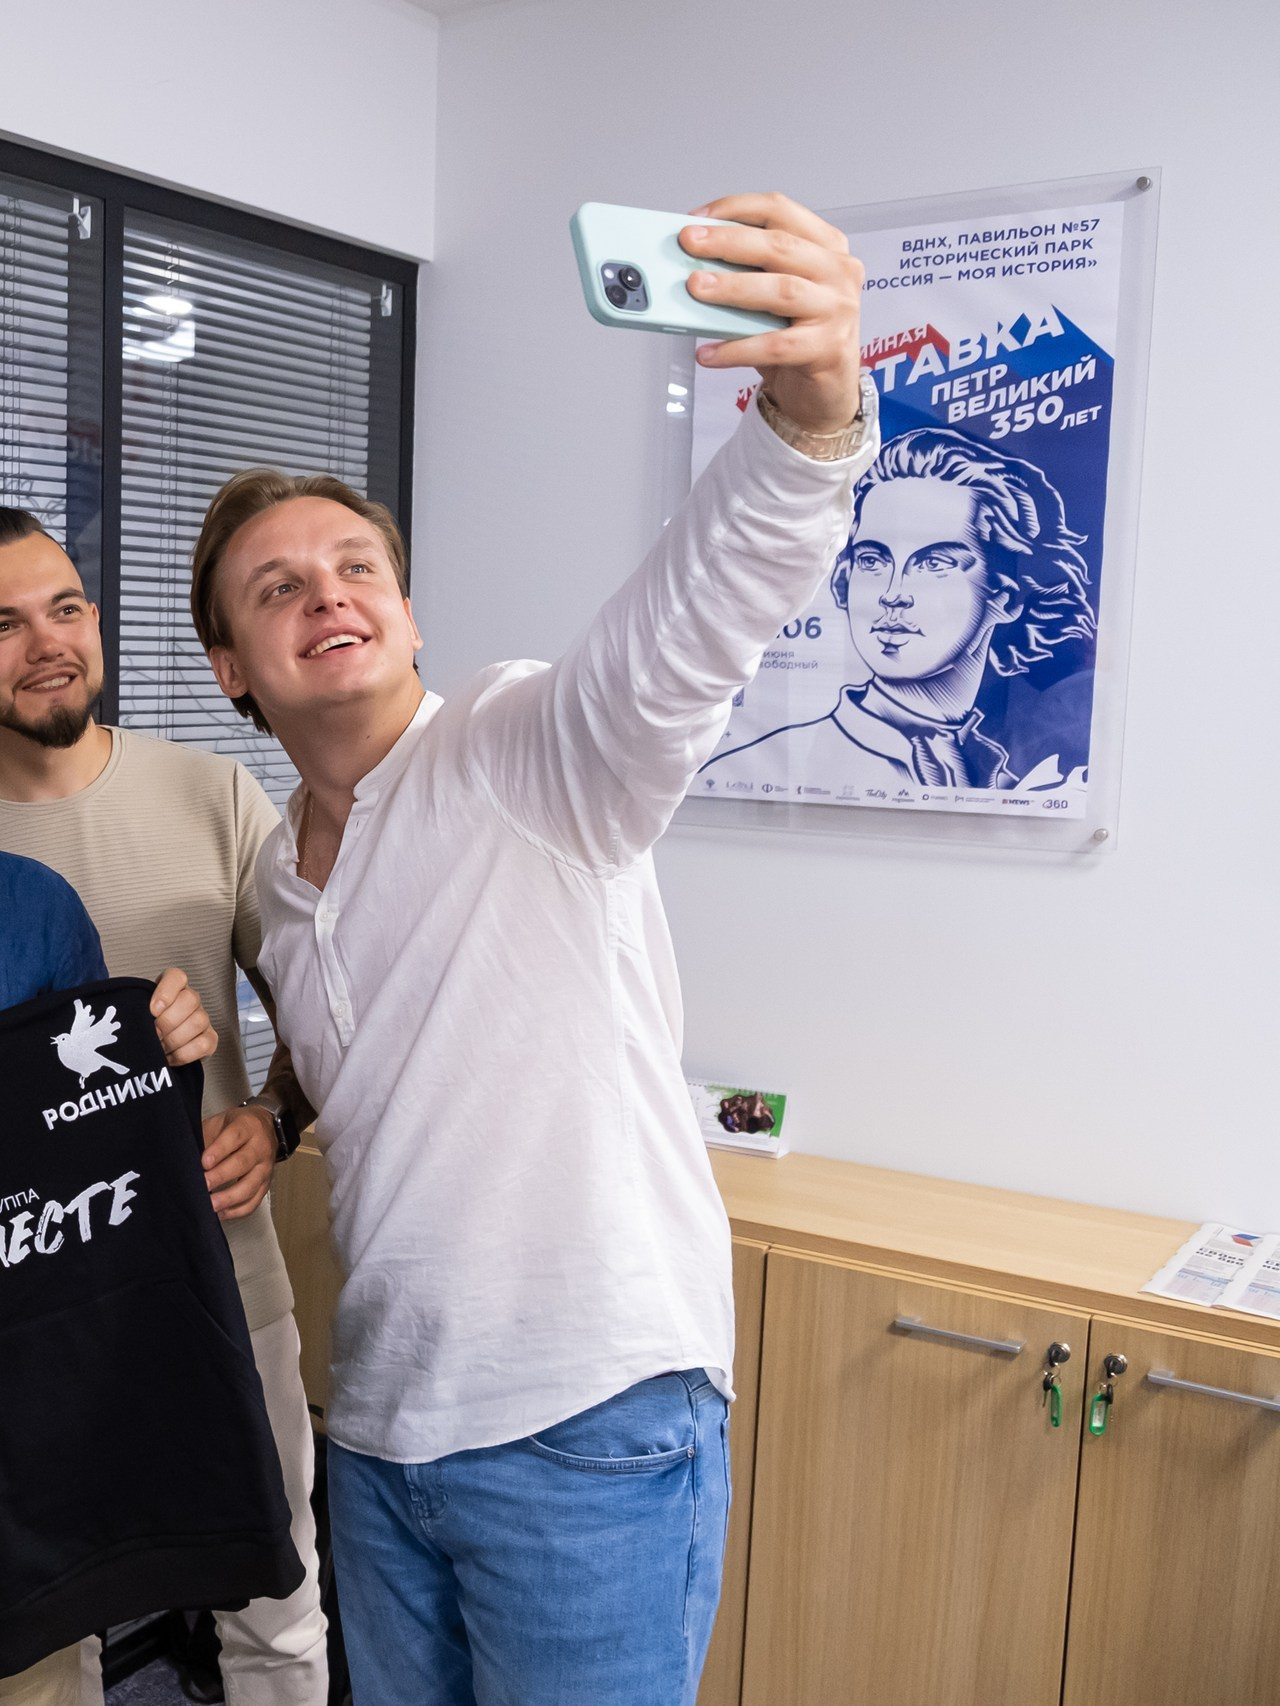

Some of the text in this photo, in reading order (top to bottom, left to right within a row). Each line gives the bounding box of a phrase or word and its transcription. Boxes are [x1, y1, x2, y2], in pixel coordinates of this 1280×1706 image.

[899, 237, 1094, 270] ИСТОРИЧЕСКИЙ ПАРК
[901, 218, 1101, 253] ВДНХ, ПАВИЛЬОН №57
[957, 266, 996, 282] МОЯ
[1001, 257, 1098, 277] ИСТОРИЯ»
[930, 363, 1008, 406] ПЕТР
[947, 354, 1097, 424] ВЕЛИКИЙ
[988, 395, 1103, 441] 350 ЛЕТ
[42, 1066, 173, 1131] РОДНИКИ
